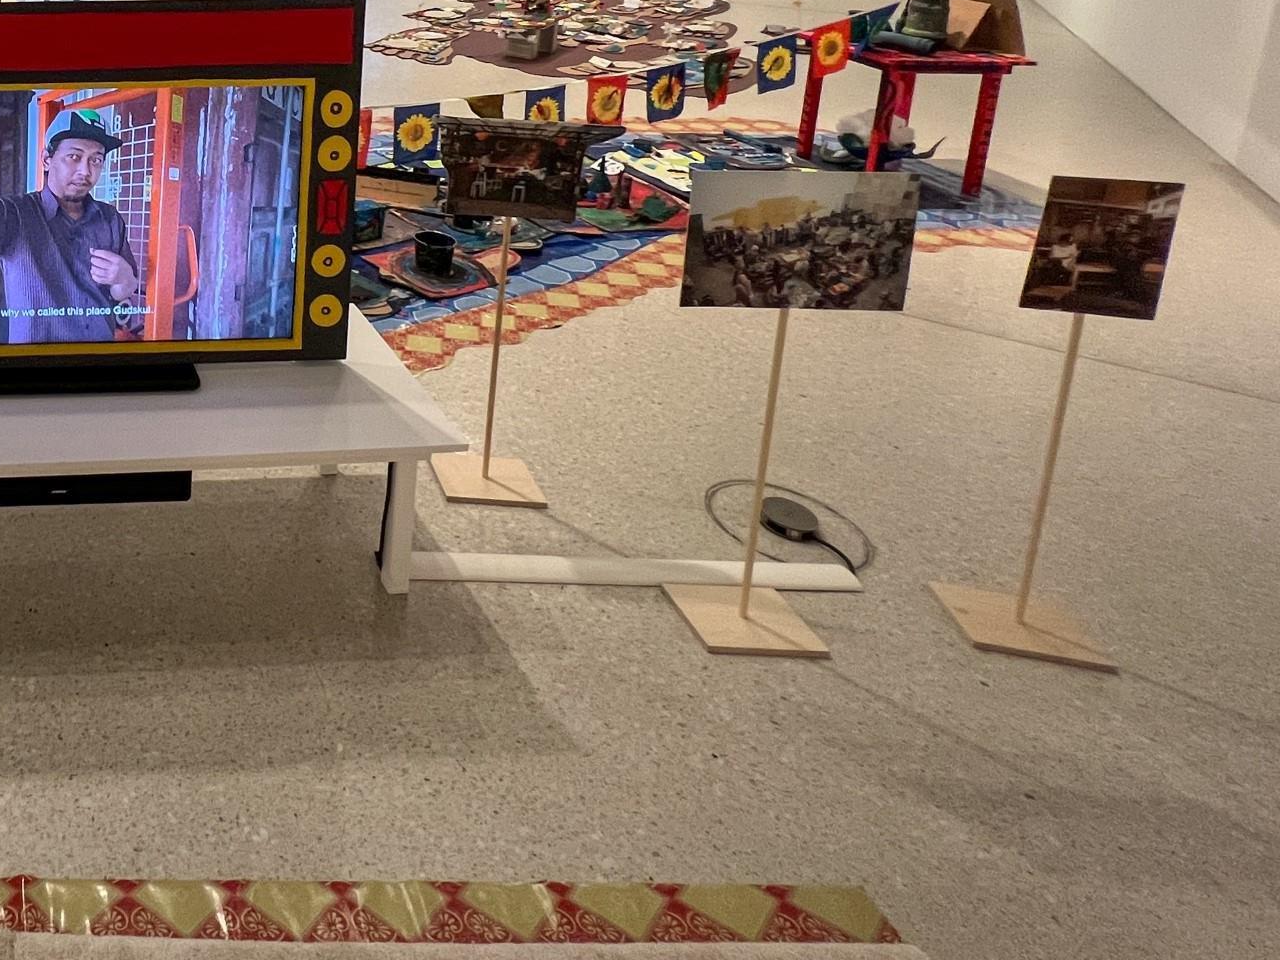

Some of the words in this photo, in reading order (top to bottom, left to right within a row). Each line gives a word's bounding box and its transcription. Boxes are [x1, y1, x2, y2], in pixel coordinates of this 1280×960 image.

[1, 308, 20, 318] why
[37, 307, 65, 316] called
[67, 306, 83, 315] this
[86, 306, 111, 316] place
